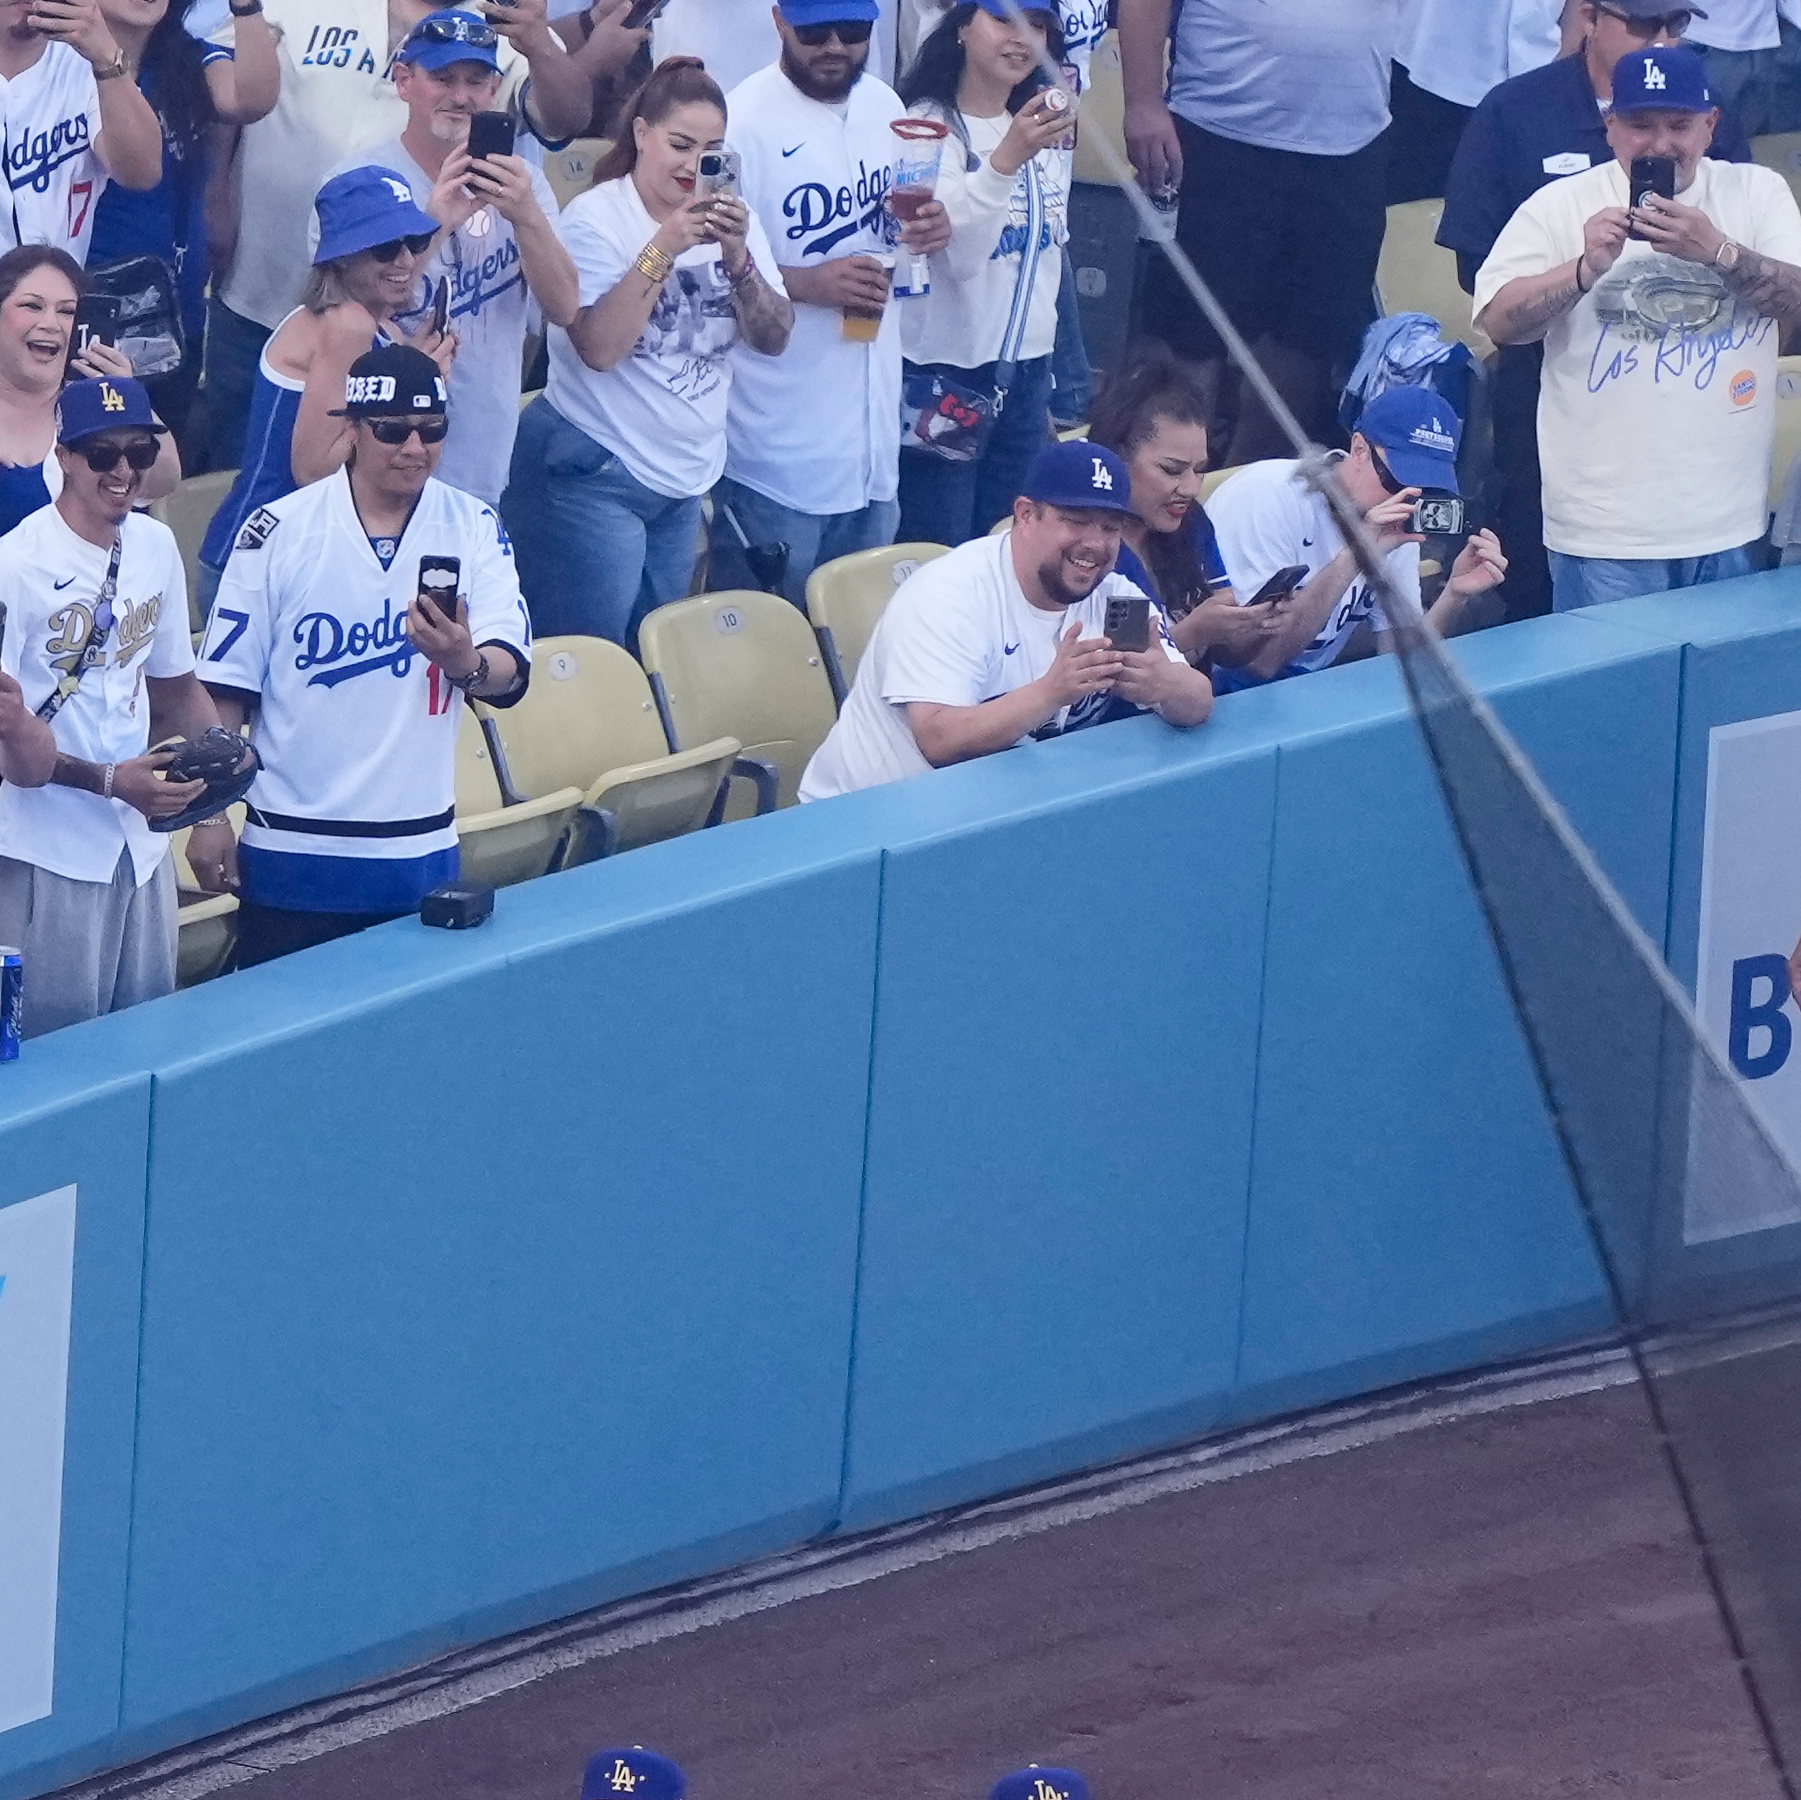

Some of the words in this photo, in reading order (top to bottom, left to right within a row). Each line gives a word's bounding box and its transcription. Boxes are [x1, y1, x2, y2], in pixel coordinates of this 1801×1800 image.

[302, 25, 359, 68] LOS
[1644, 58, 1666, 90] LA
[783, 160, 892, 238] Dodge
[1587, 322, 1639, 393] Los
[99, 382, 126, 412] LA
[1091, 458, 1113, 491] LA
[293, 597, 410, 678] Dodg
[722, 613, 737, 628] 10
[610, 1759, 636, 1793] LA
